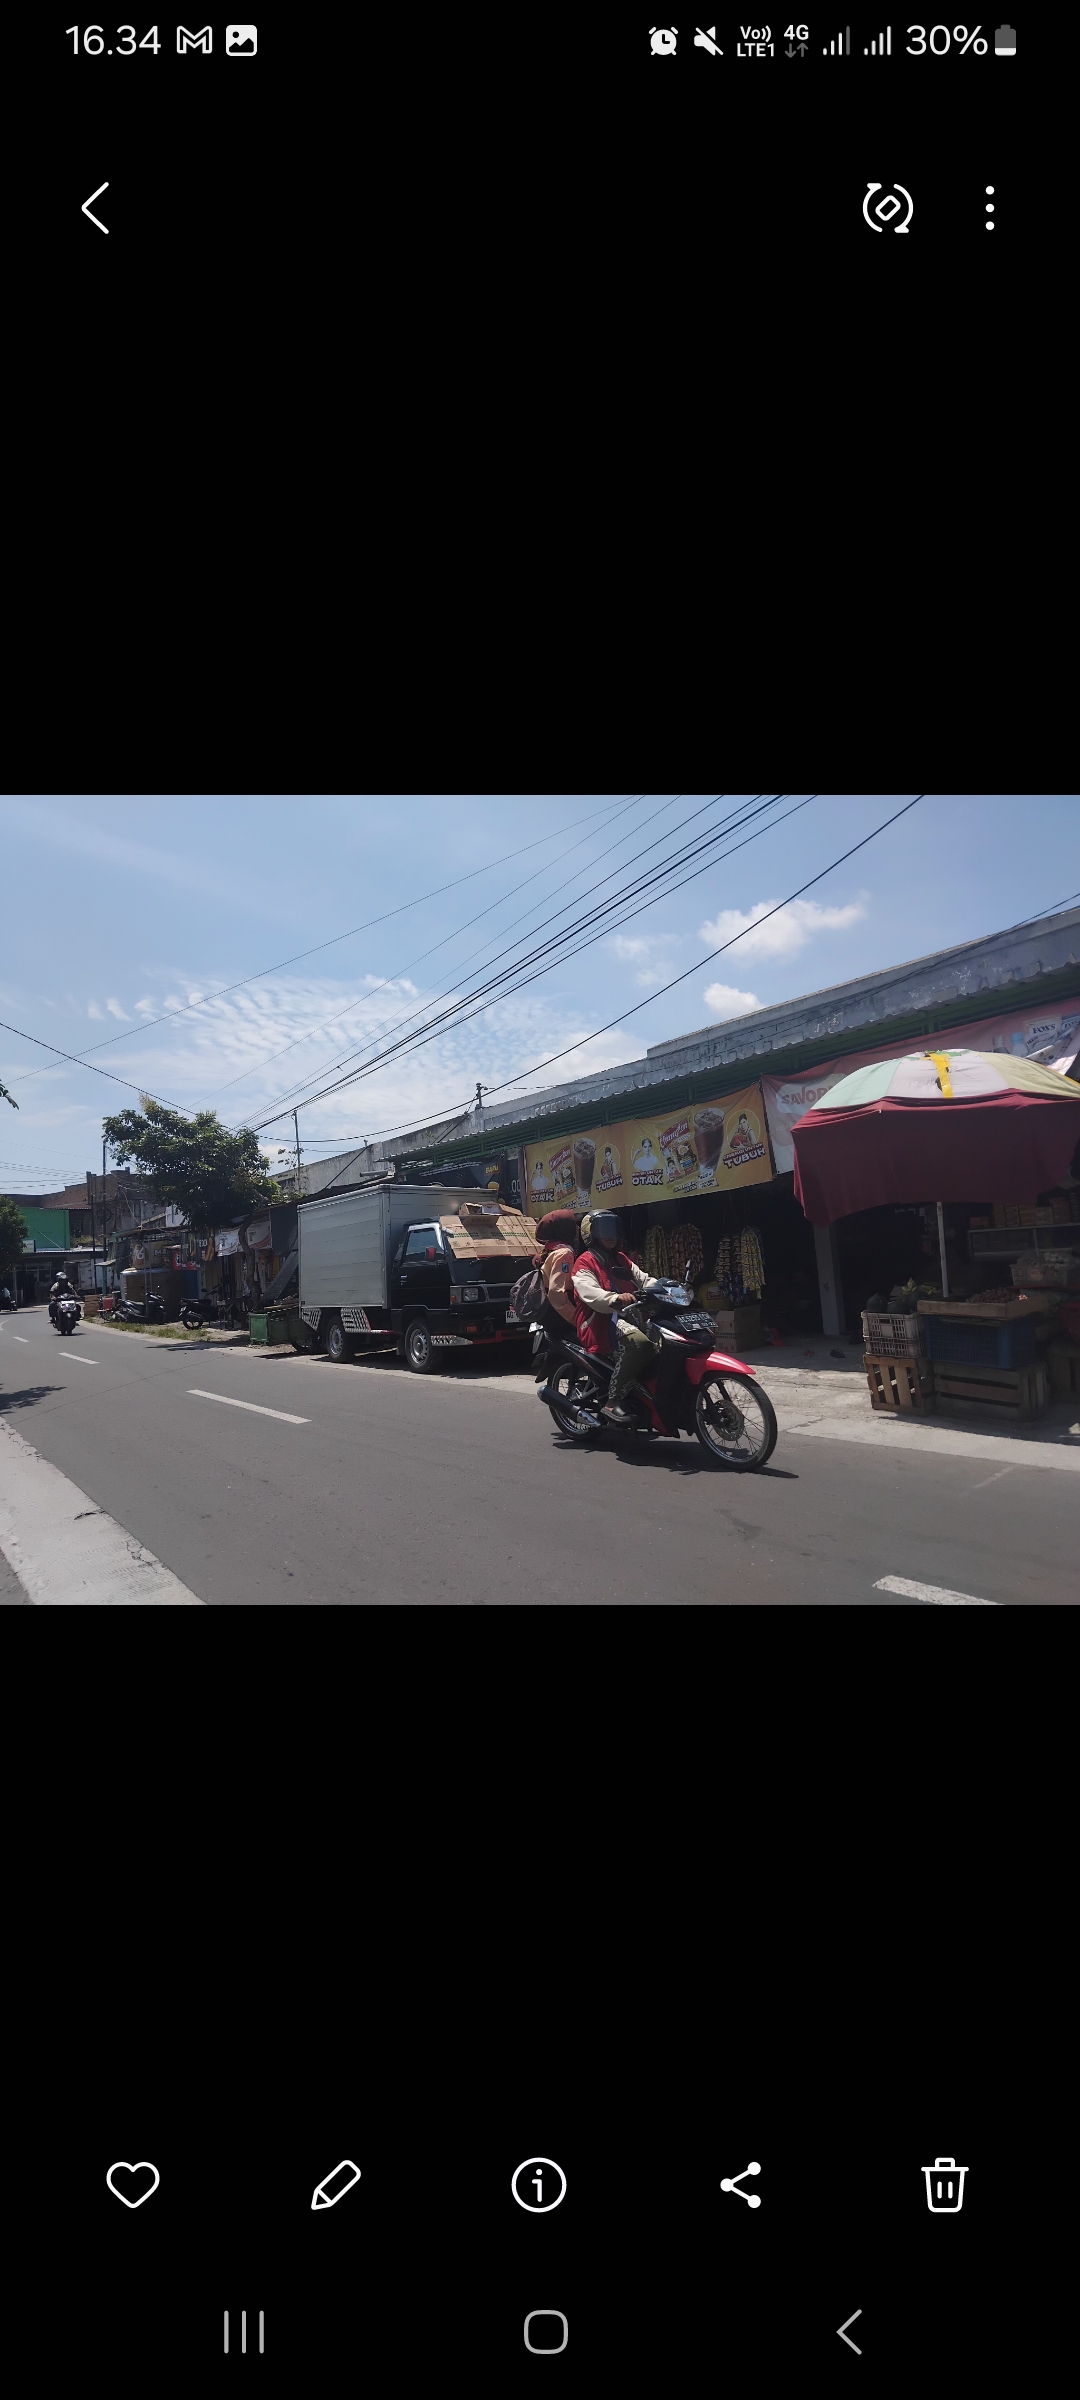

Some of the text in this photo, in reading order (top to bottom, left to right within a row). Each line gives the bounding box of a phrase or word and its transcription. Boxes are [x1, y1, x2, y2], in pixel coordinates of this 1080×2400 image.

[781, 1086, 833, 1105] SAVOR
[724, 1147, 765, 1168] TUBUH
[596, 1178, 622, 1192] TUBUH
[632, 1174, 662, 1185] OTAK
[531, 1193, 553, 1202] OTAK
